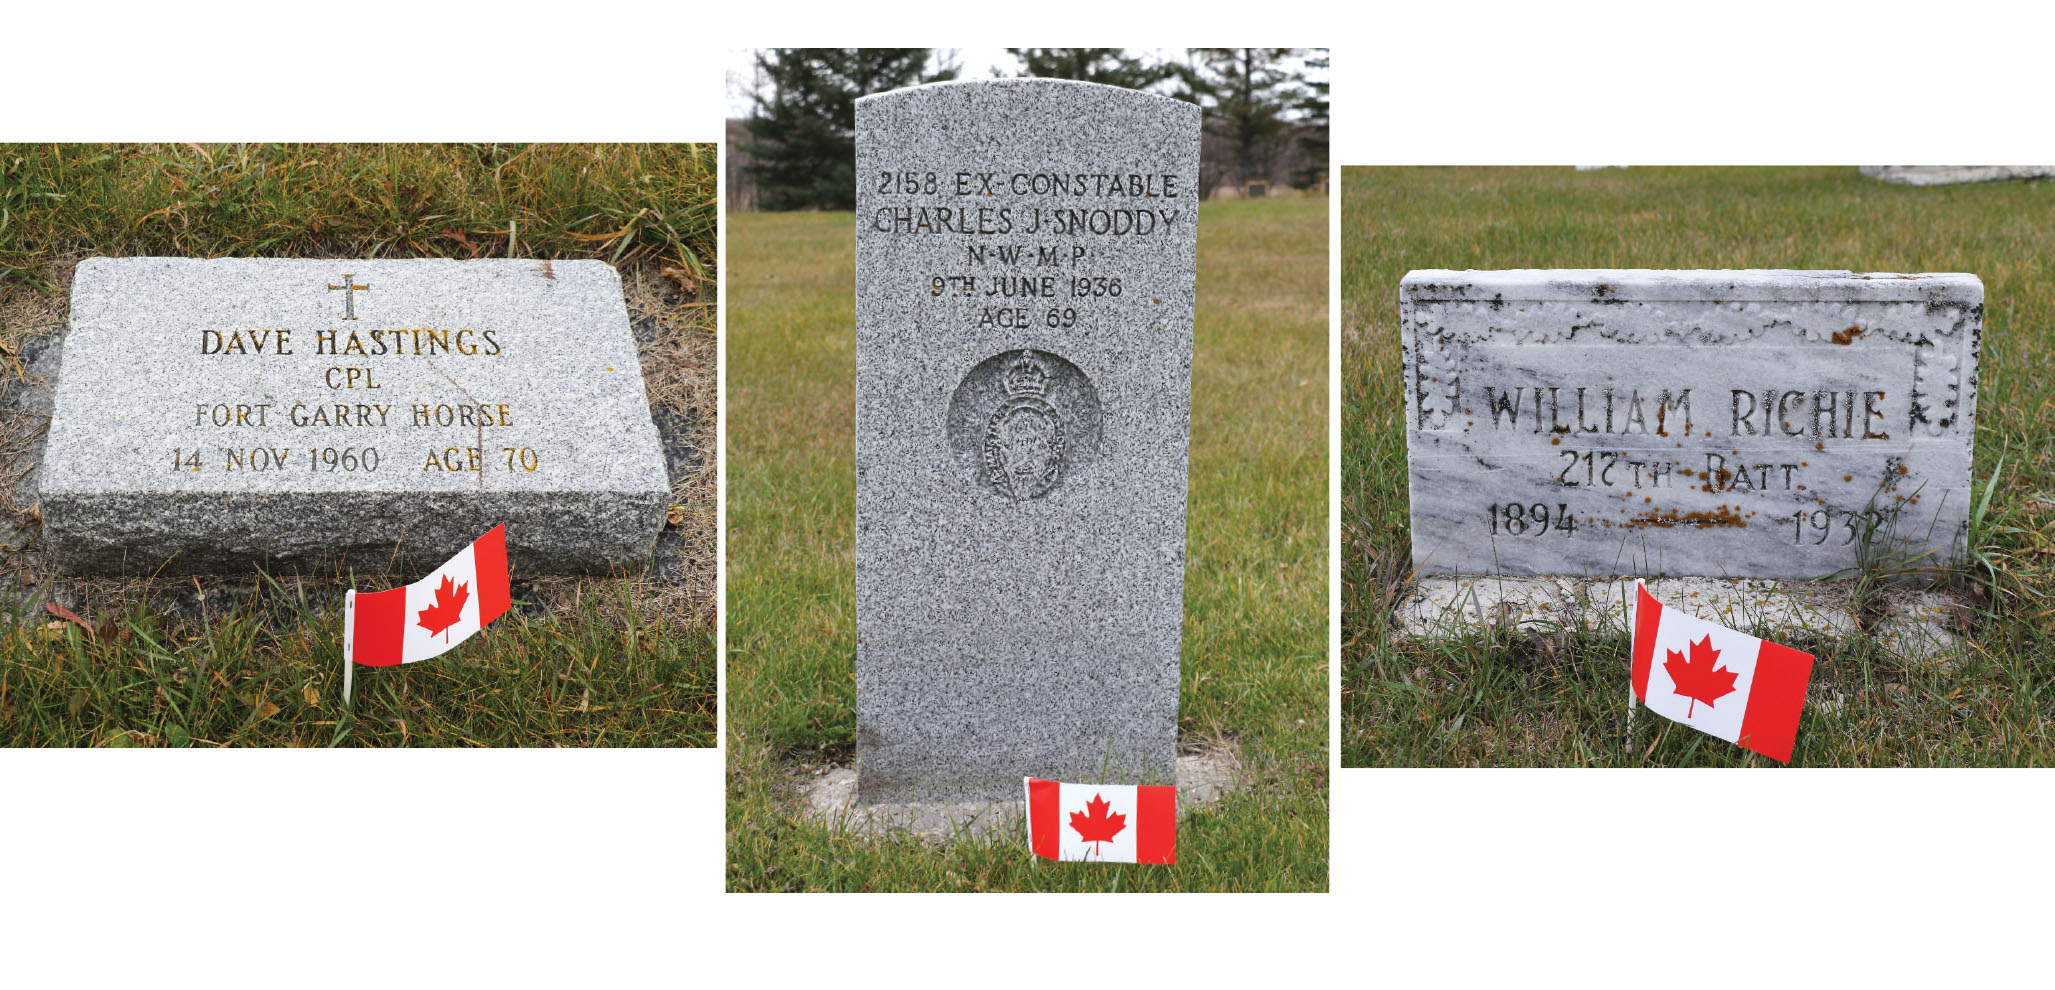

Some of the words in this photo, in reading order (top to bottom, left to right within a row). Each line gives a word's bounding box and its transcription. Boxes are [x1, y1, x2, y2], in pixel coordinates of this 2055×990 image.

[878, 171, 939, 196] 2158
[875, 207, 1013, 235] CHARLES
[931, 276, 976, 298] 9TH
[985, 276, 1056, 298] JUNE
[1070, 276, 1123, 298] 1936
[978, 307, 1031, 329] AGE
[1046, 307, 1077, 329] 69
[201, 329, 293, 356] DAVE
[316, 328, 502, 356] HASTINGS
[325, 367, 382, 390] CPL
[196, 403, 270, 427] FORT
[290, 403, 391, 427] GARRY
[412, 403, 514, 427] HORSE
[1484, 386, 1695, 436] WILLIAM
[1731, 389, 1891, 441] RICHIE
[172, 447, 202, 473] 14
[226, 448, 289, 473] NOV
[309, 447, 381, 473] 1960
[423, 447, 483, 473] AGE
[502, 447, 540, 473] 70
[1487, 502, 1579, 539] 1894
